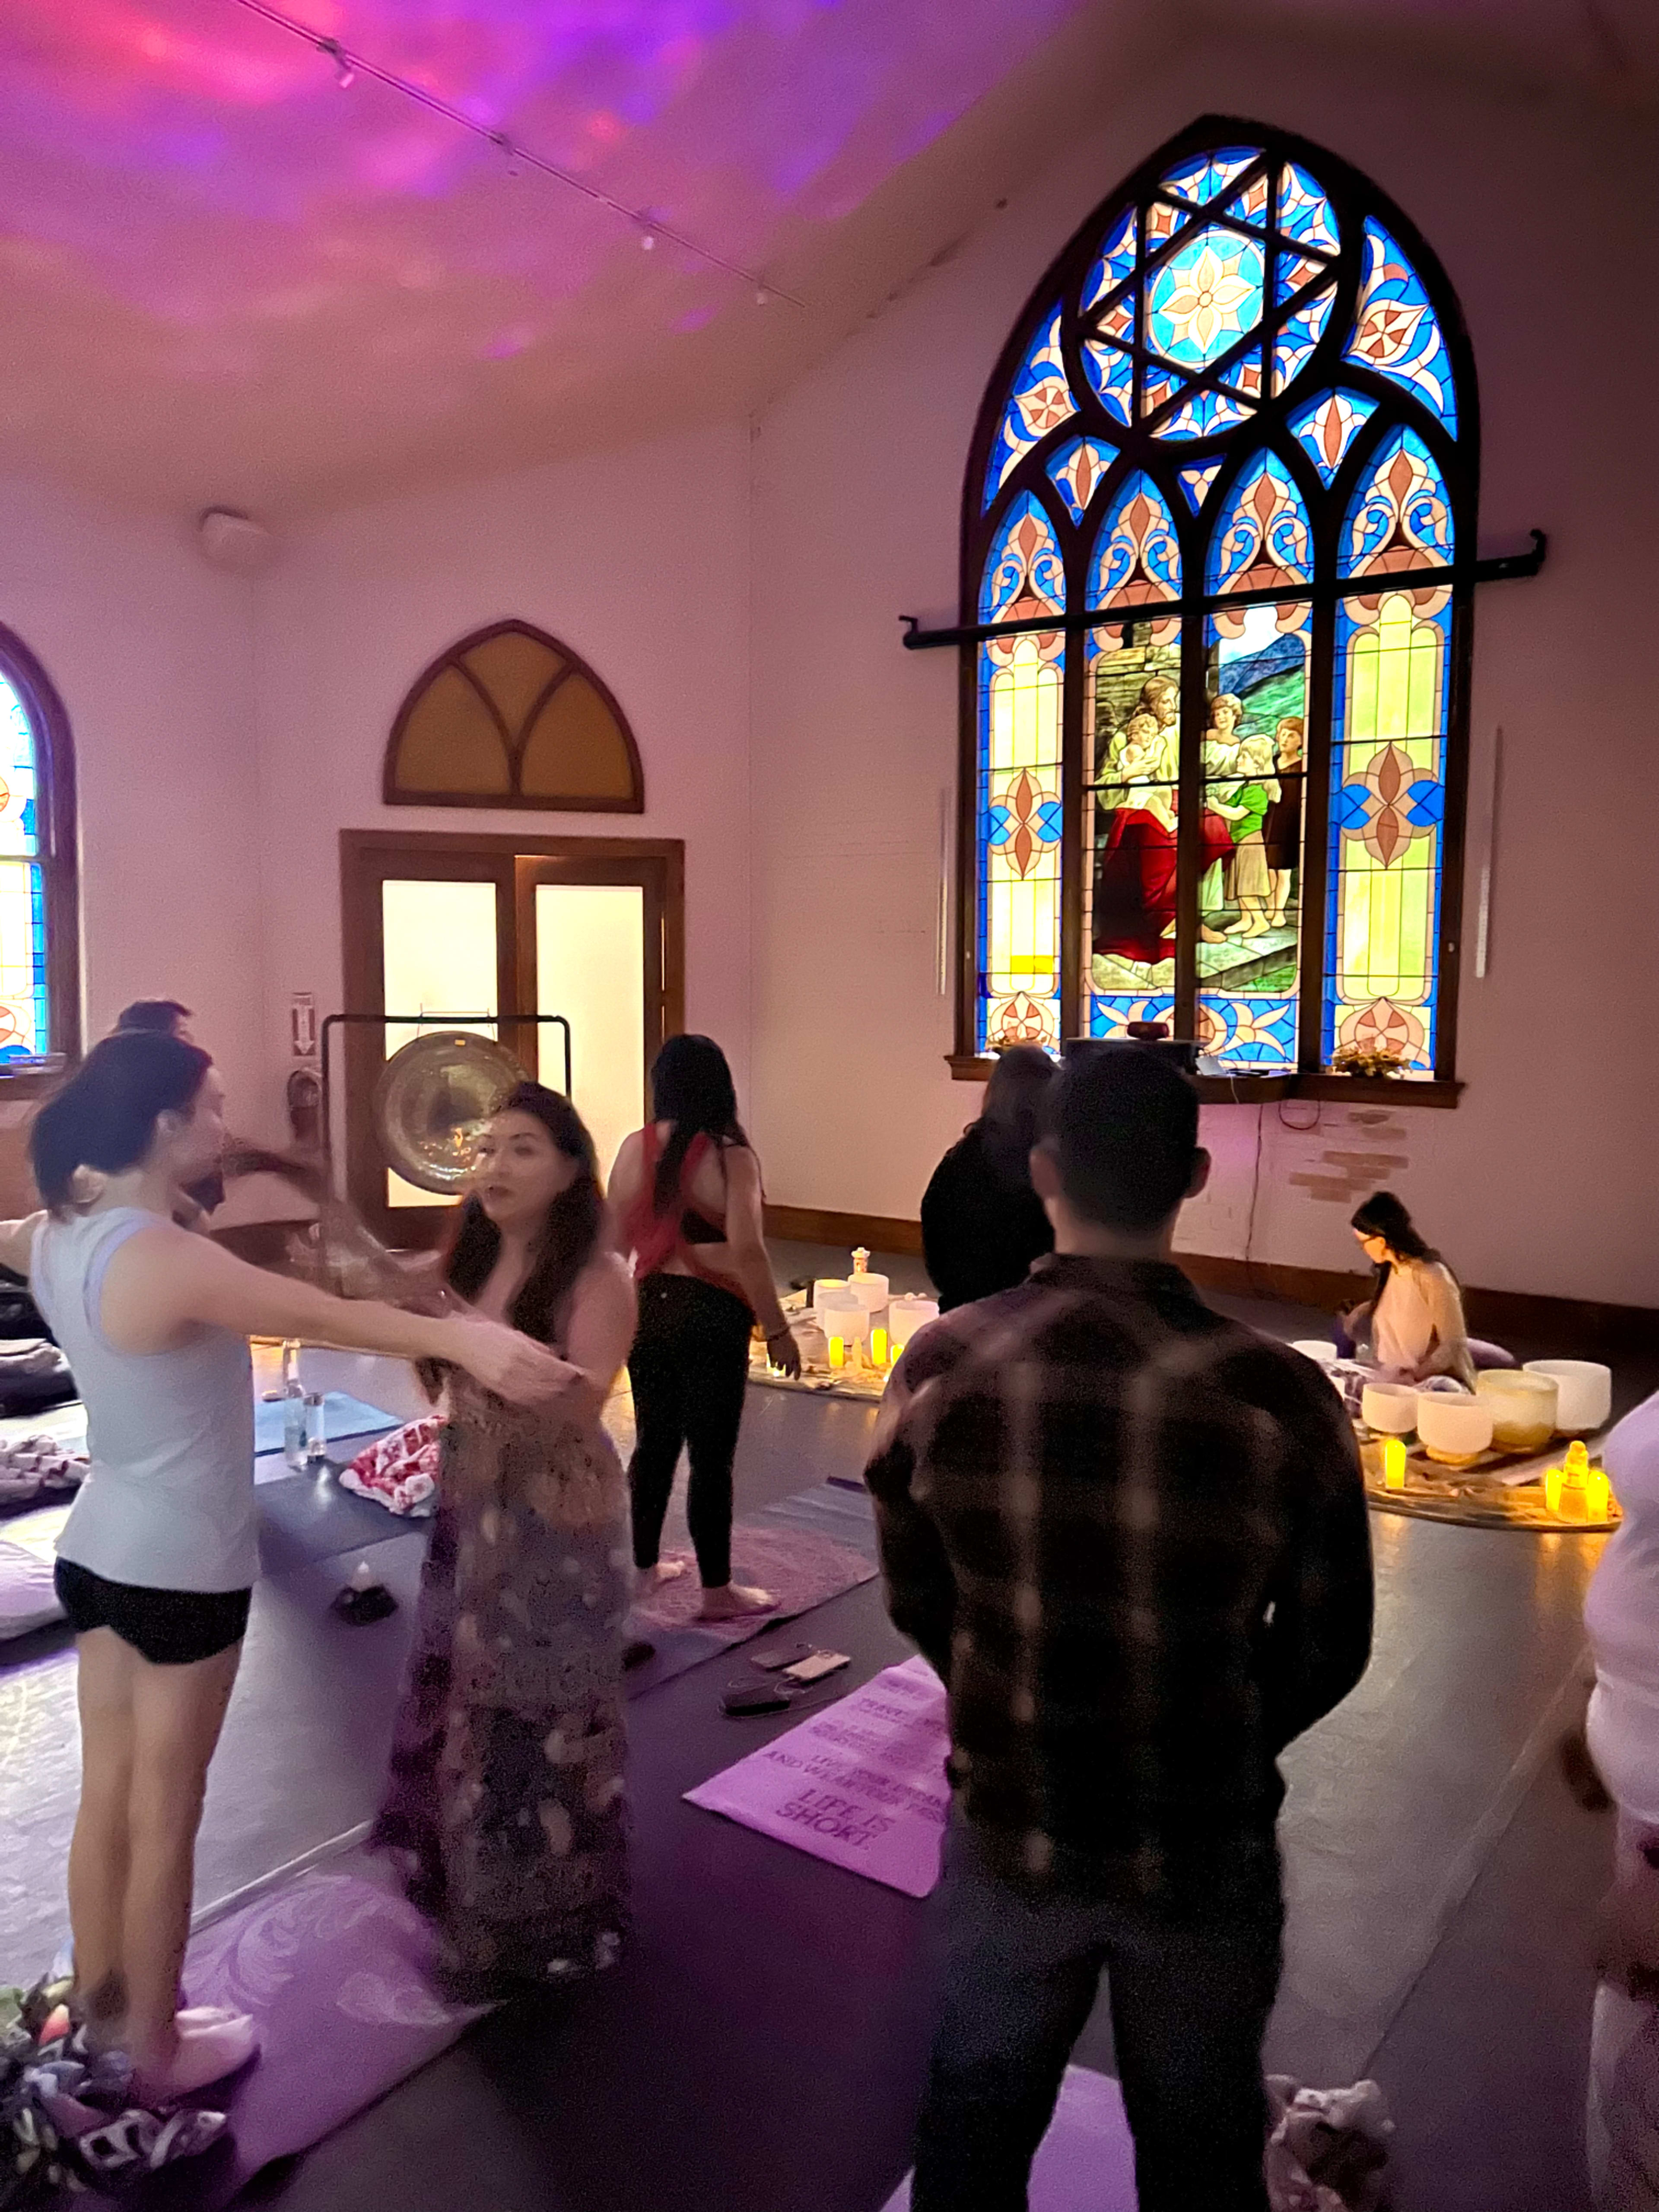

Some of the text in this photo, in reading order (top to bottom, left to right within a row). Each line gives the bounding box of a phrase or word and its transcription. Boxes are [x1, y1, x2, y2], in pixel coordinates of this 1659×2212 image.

[762, 1751, 803, 1768] AND
[776, 1802, 878, 1850] SHORT.
[798, 1789, 896, 1832] LIFE IS
